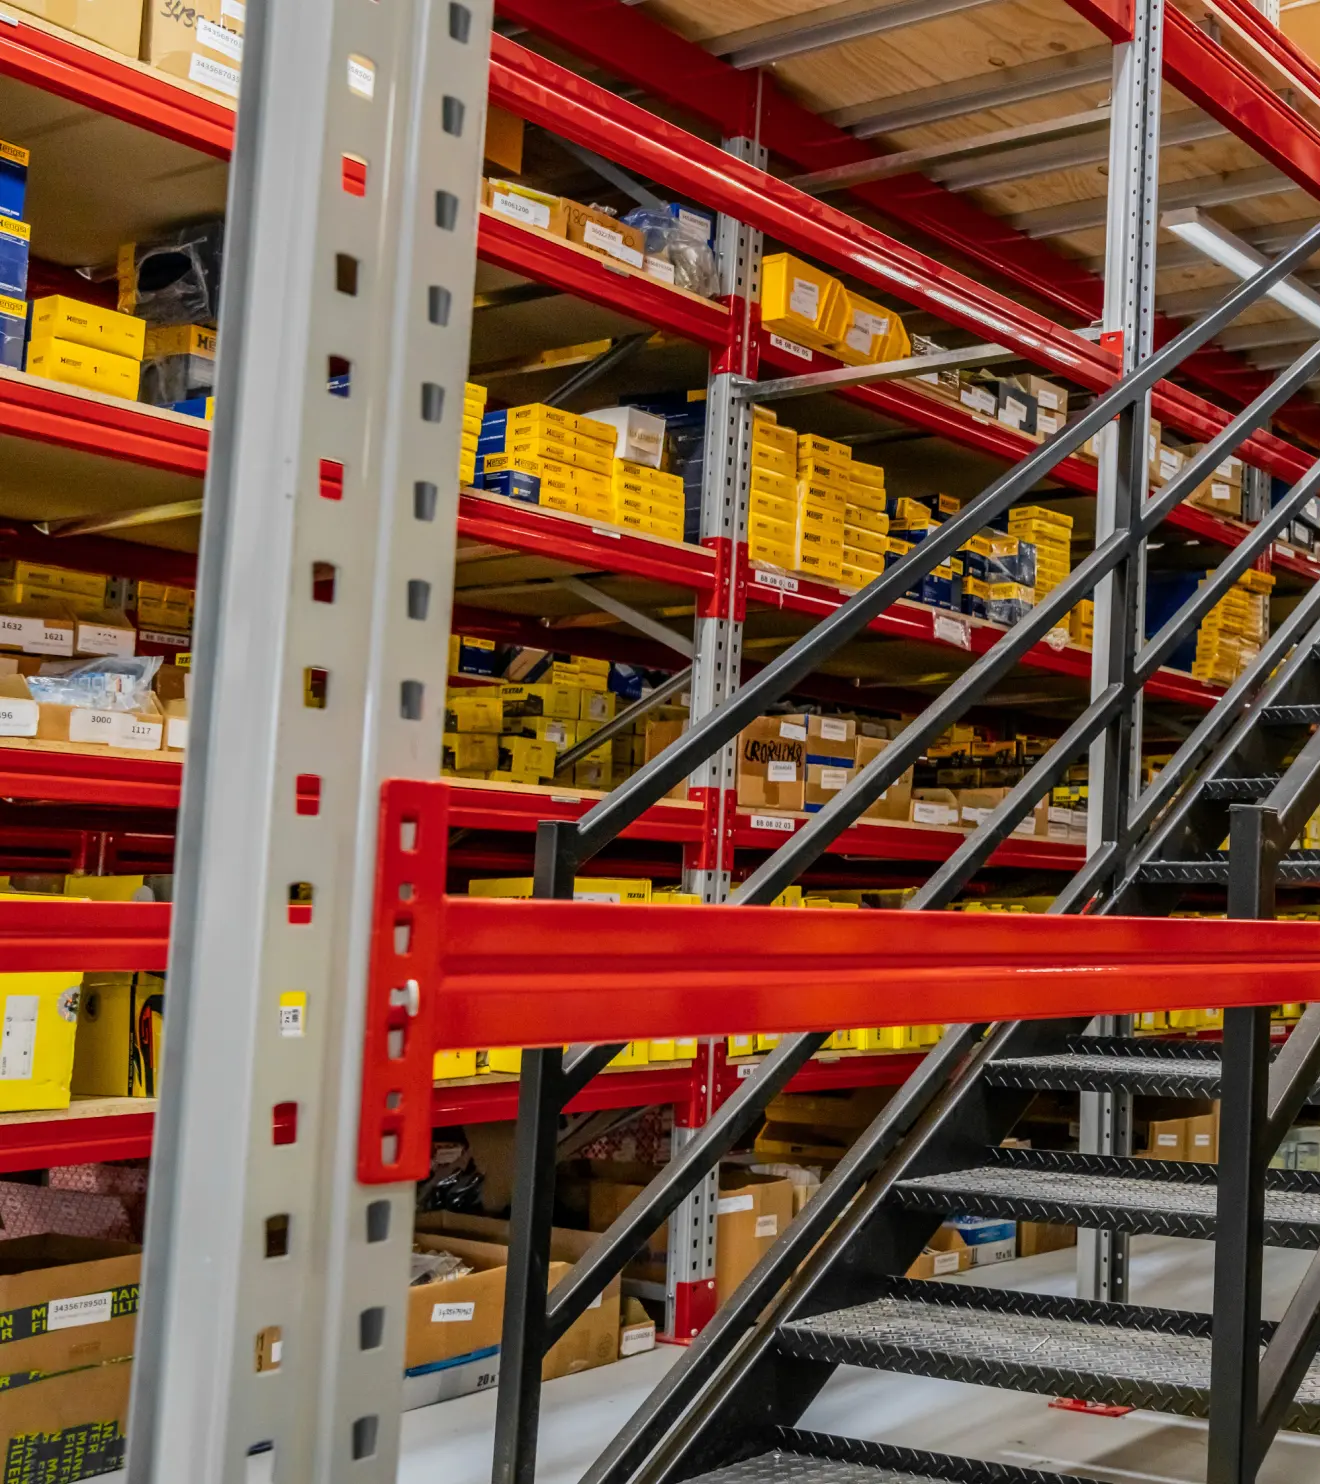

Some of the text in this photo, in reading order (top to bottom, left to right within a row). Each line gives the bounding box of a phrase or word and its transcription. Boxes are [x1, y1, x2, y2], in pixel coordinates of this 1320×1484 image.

[44, 632, 64, 642] 1621
[91, 715, 112, 724] 3000
[131, 725, 151, 734] 1117
[53, 1298, 108, 1313] 34356789501
